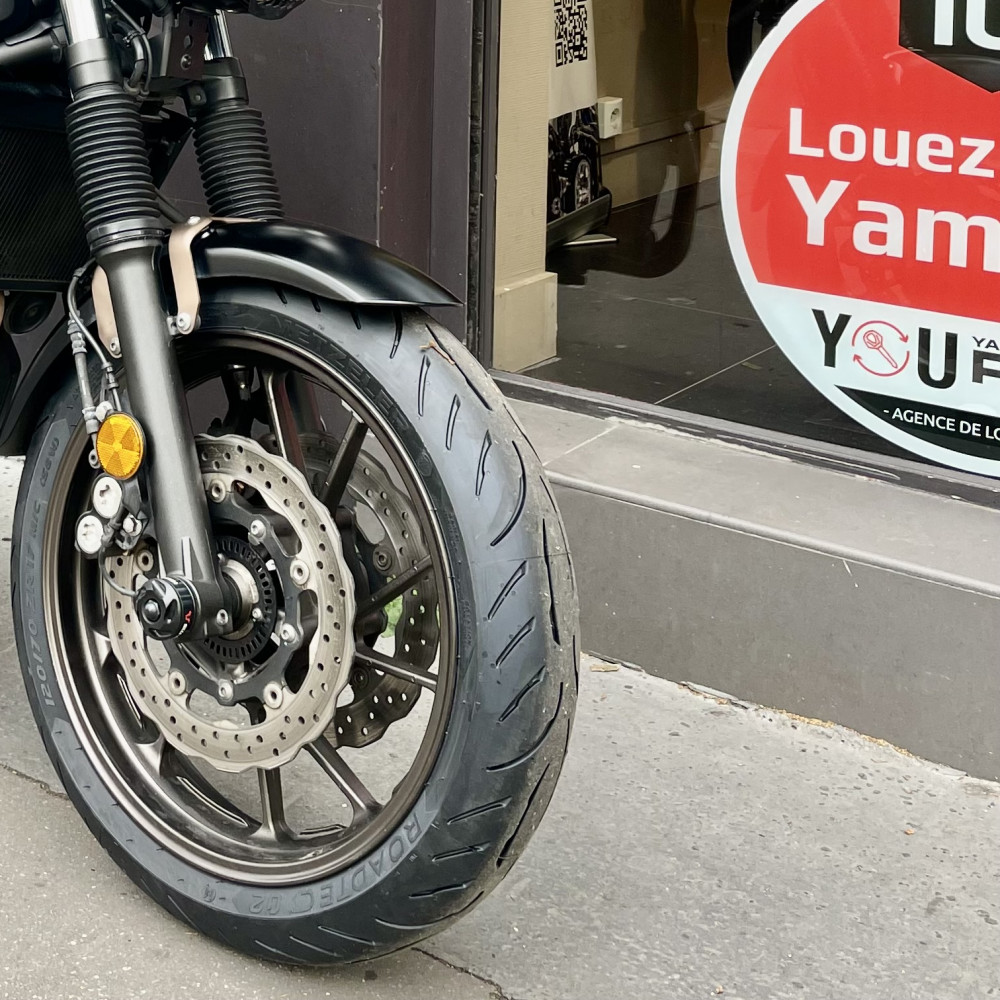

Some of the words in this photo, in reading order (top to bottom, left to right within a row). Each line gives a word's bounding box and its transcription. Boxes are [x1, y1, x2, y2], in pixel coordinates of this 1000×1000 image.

[788, 107, 996, 179] Louez
[785, 173, 1000, 274] Yam
[891, 407, 956, 431] AGENCE
[959, 420, 982, 437] DE
[28, 618, 56, 707] 120/70
[288, 810, 423, 916] ROADTEC
